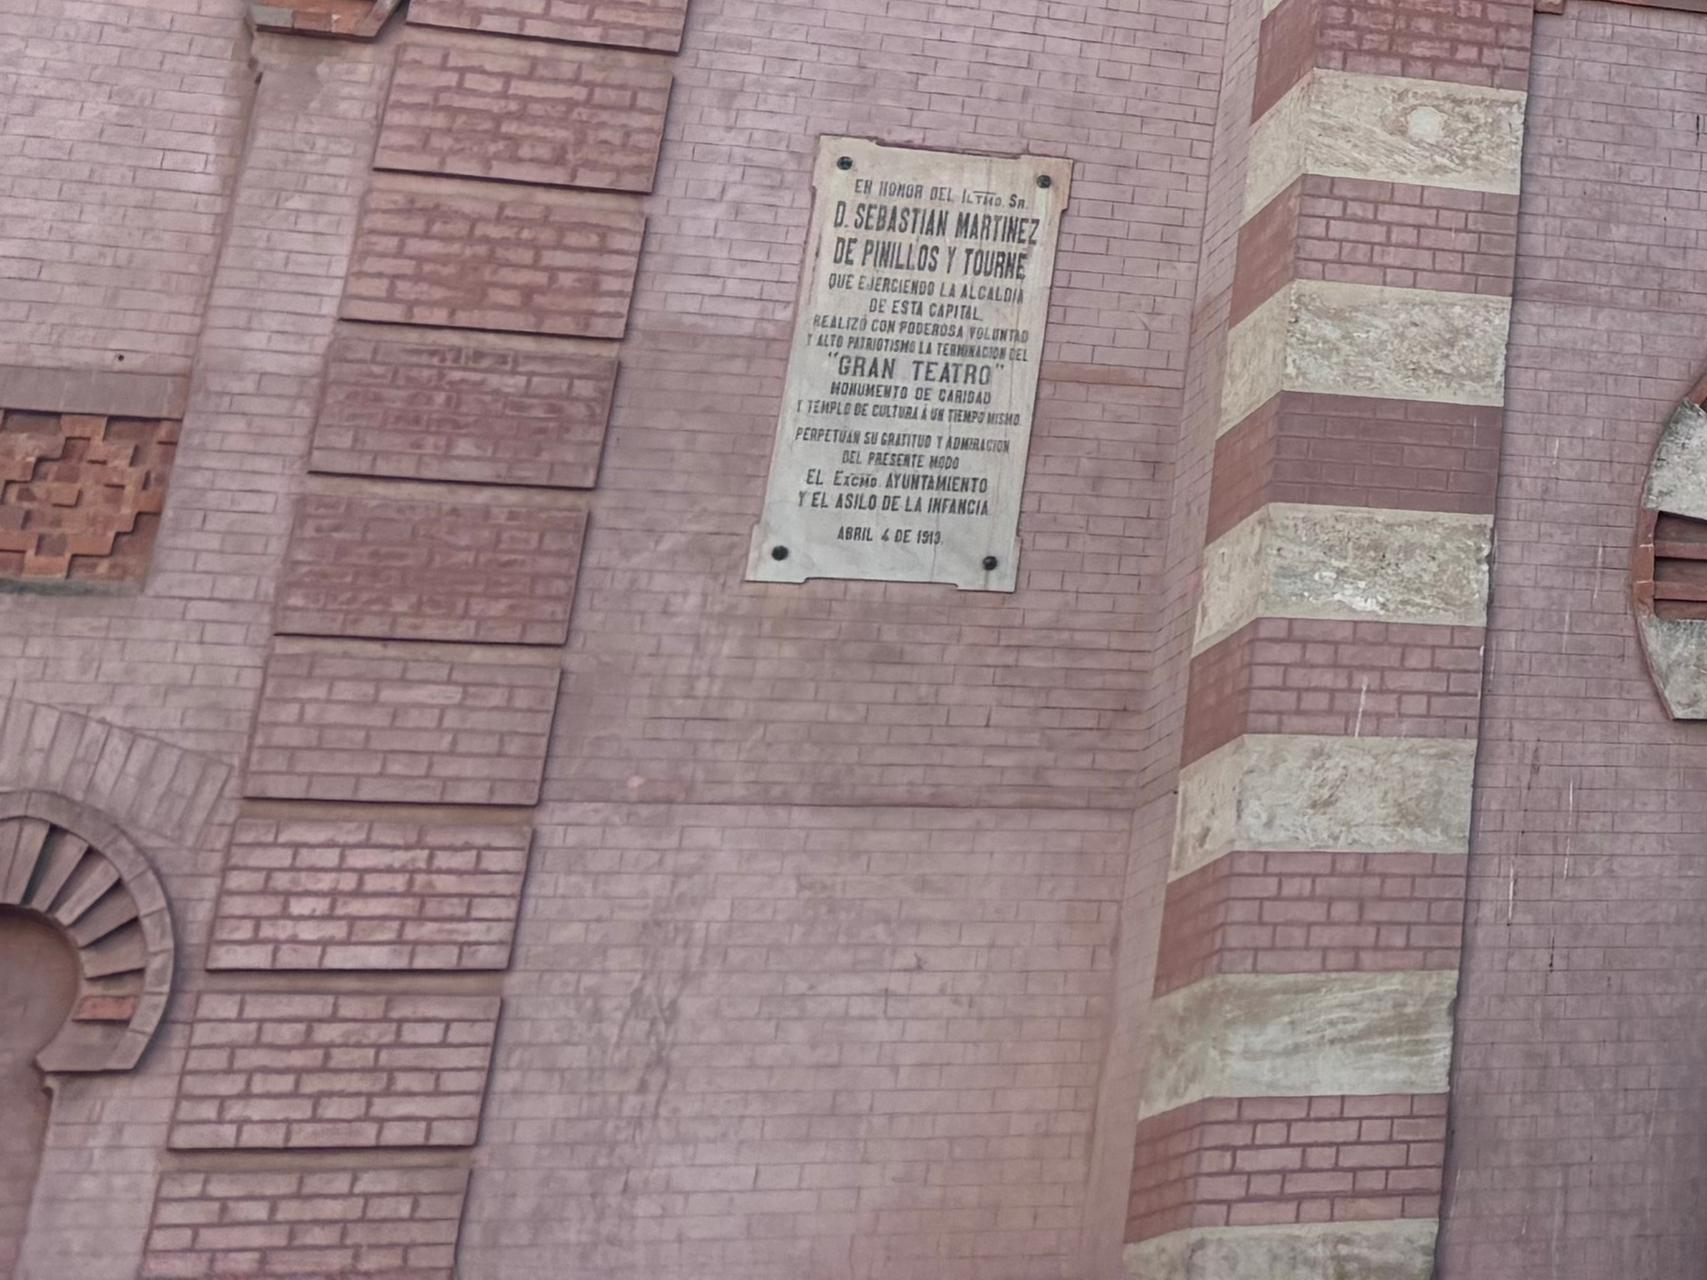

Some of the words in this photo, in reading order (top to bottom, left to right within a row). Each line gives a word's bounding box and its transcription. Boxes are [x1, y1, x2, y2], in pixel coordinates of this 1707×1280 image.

[855, 179, 872, 195] EN
[879, 181, 923, 199] HONOR
[930, 186, 953, 202] DEL
[834, 201, 848, 228] D.
[854, 204, 949, 236] SEBASTIAN
[955, 212, 1040, 245] MARTINEZ
[833, 237, 857, 266] DE
[861, 239, 939, 271] PINILLOS
[946, 246, 957, 274] Y
[828, 273, 852, 290] QUE
[858, 275, 935, 296] EJERCIENDO
[940, 282, 955, 297] LA
[869, 298, 887, 313] DE
[892, 301, 923, 316] ESTA
[871, 319, 895, 333] CON
[899, 321, 963, 338] PODEROSA
[969, 327, 1029, 343] VOLUNTAD
[807, 333, 813, 346] Y
[817, 334, 843, 348] ALTO
[847, 336, 915, 354] PATRIOTISMO
[919, 341, 932, 354] LA
[1009, 348, 1028, 362] DEL
[830, 381, 907, 400] MONUMENTO
[915, 387, 931, 401] DE
[939, 388, 991, 404] CARIDAD
[797, 400, 802, 413] Y
[807, 400, 850, 416] TEMPLO
[854, 403, 867, 416] DE
[872, 404, 918, 420] CULTURA
[931, 407, 944, 421] UN
[948, 408, 984, 423] TIEMPO
[864, 432, 877, 445] SU
[881, 432, 931, 448] GRATITUD
[937, 436, 943, 448] Y
[842, 451, 861, 464] DEL
[868, 452, 924, 468] PRESENTE
[929, 456, 959, 469] MODO
[806, 469, 823, 485] EL
[885, 473, 987, 493] AYUNTAMIENTO
[798, 491, 805, 507] Y
[811, 492, 828, 508] EL
[835, 493, 877, 510] ASILO
[882, 496, 900, 512] DE
[905, 496, 922, 513] LA
[927, 498, 988, 516] INFANCIA
[837, 526, 873, 541] ABRIL
[881, 528, 889, 541] 4
[894, 529, 912, 543] DE
